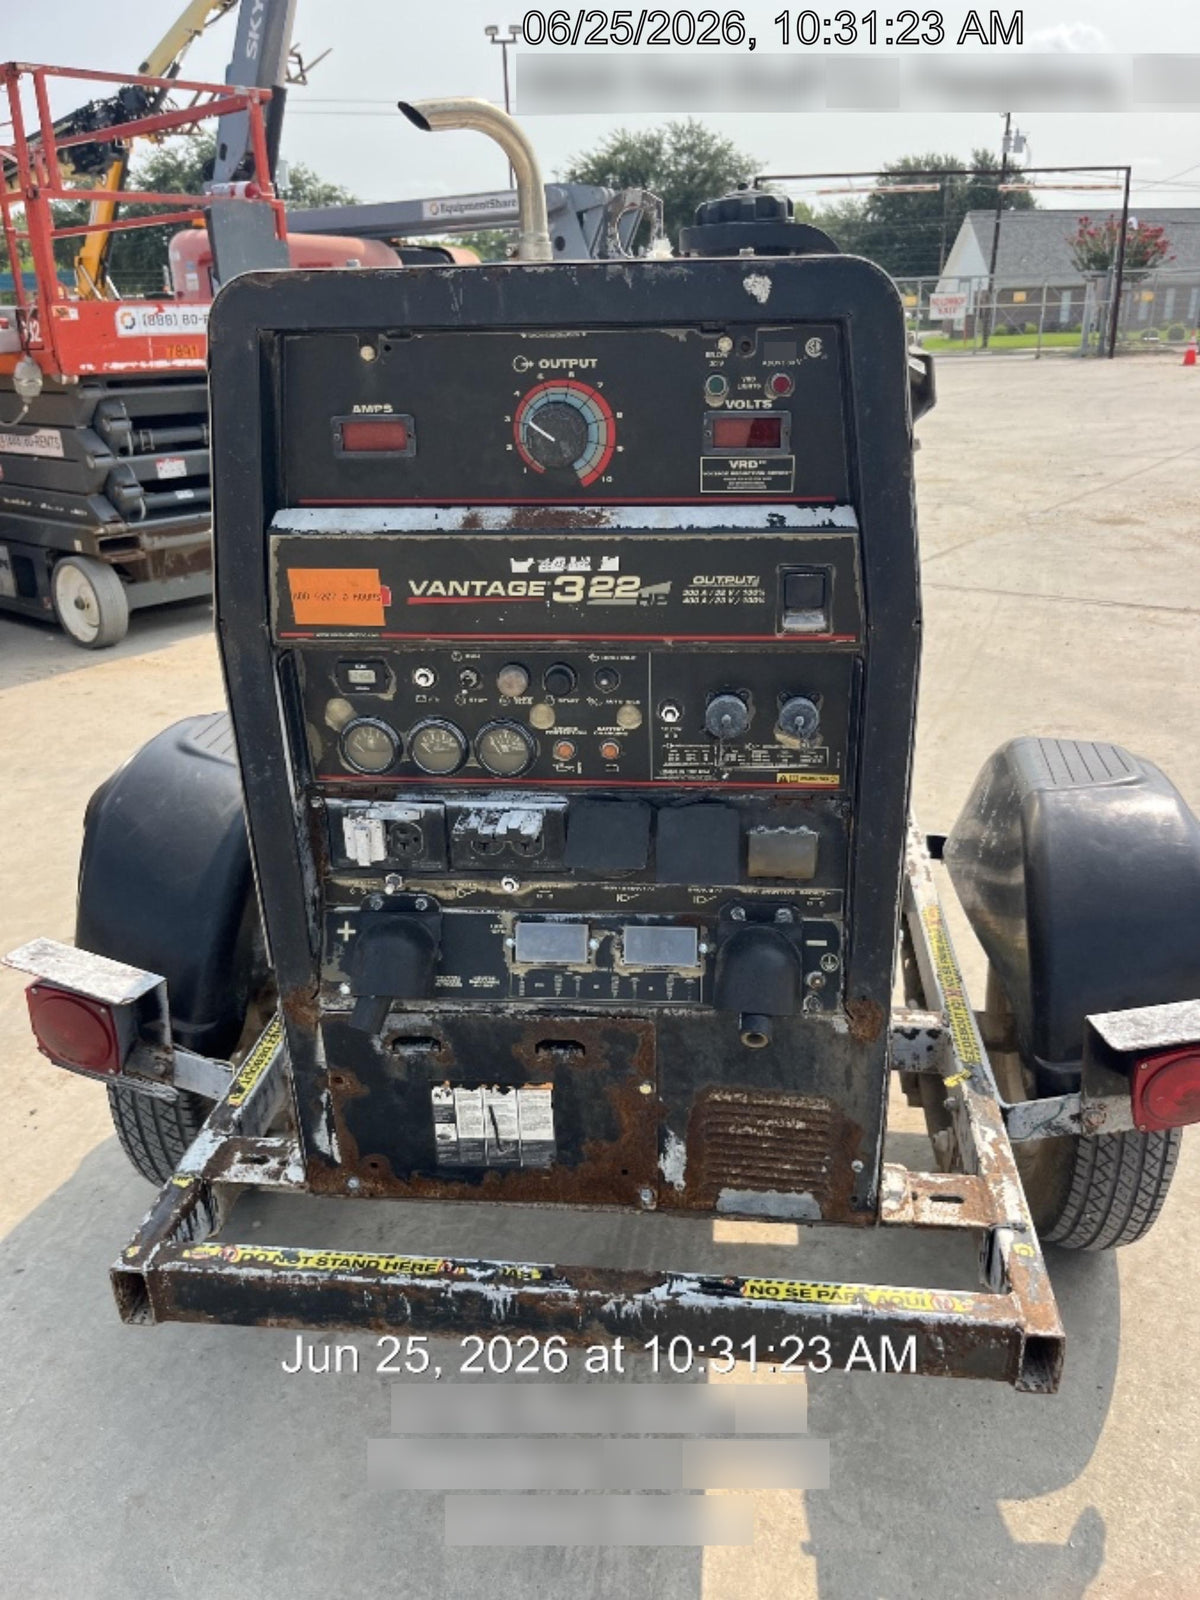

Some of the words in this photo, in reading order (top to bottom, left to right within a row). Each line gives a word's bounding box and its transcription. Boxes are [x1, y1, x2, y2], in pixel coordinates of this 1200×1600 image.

[440, 198, 517, 214] EquipmentShare
[538, 358, 598, 369] OUTPUT
[352, 403, 393, 414] AMPS
[724, 399, 773, 410] VOLTS
[692, 575, 756, 585] OUTPUT
[408, 580, 546, 597] VANTAGE
[553, 575, 641, 604] 322
[316, 1255, 381, 1271] STAND
[383, 1259, 438, 1273] HERE
[749, 1284, 780, 1297] NO
[785, 1286, 811, 1299] SE
